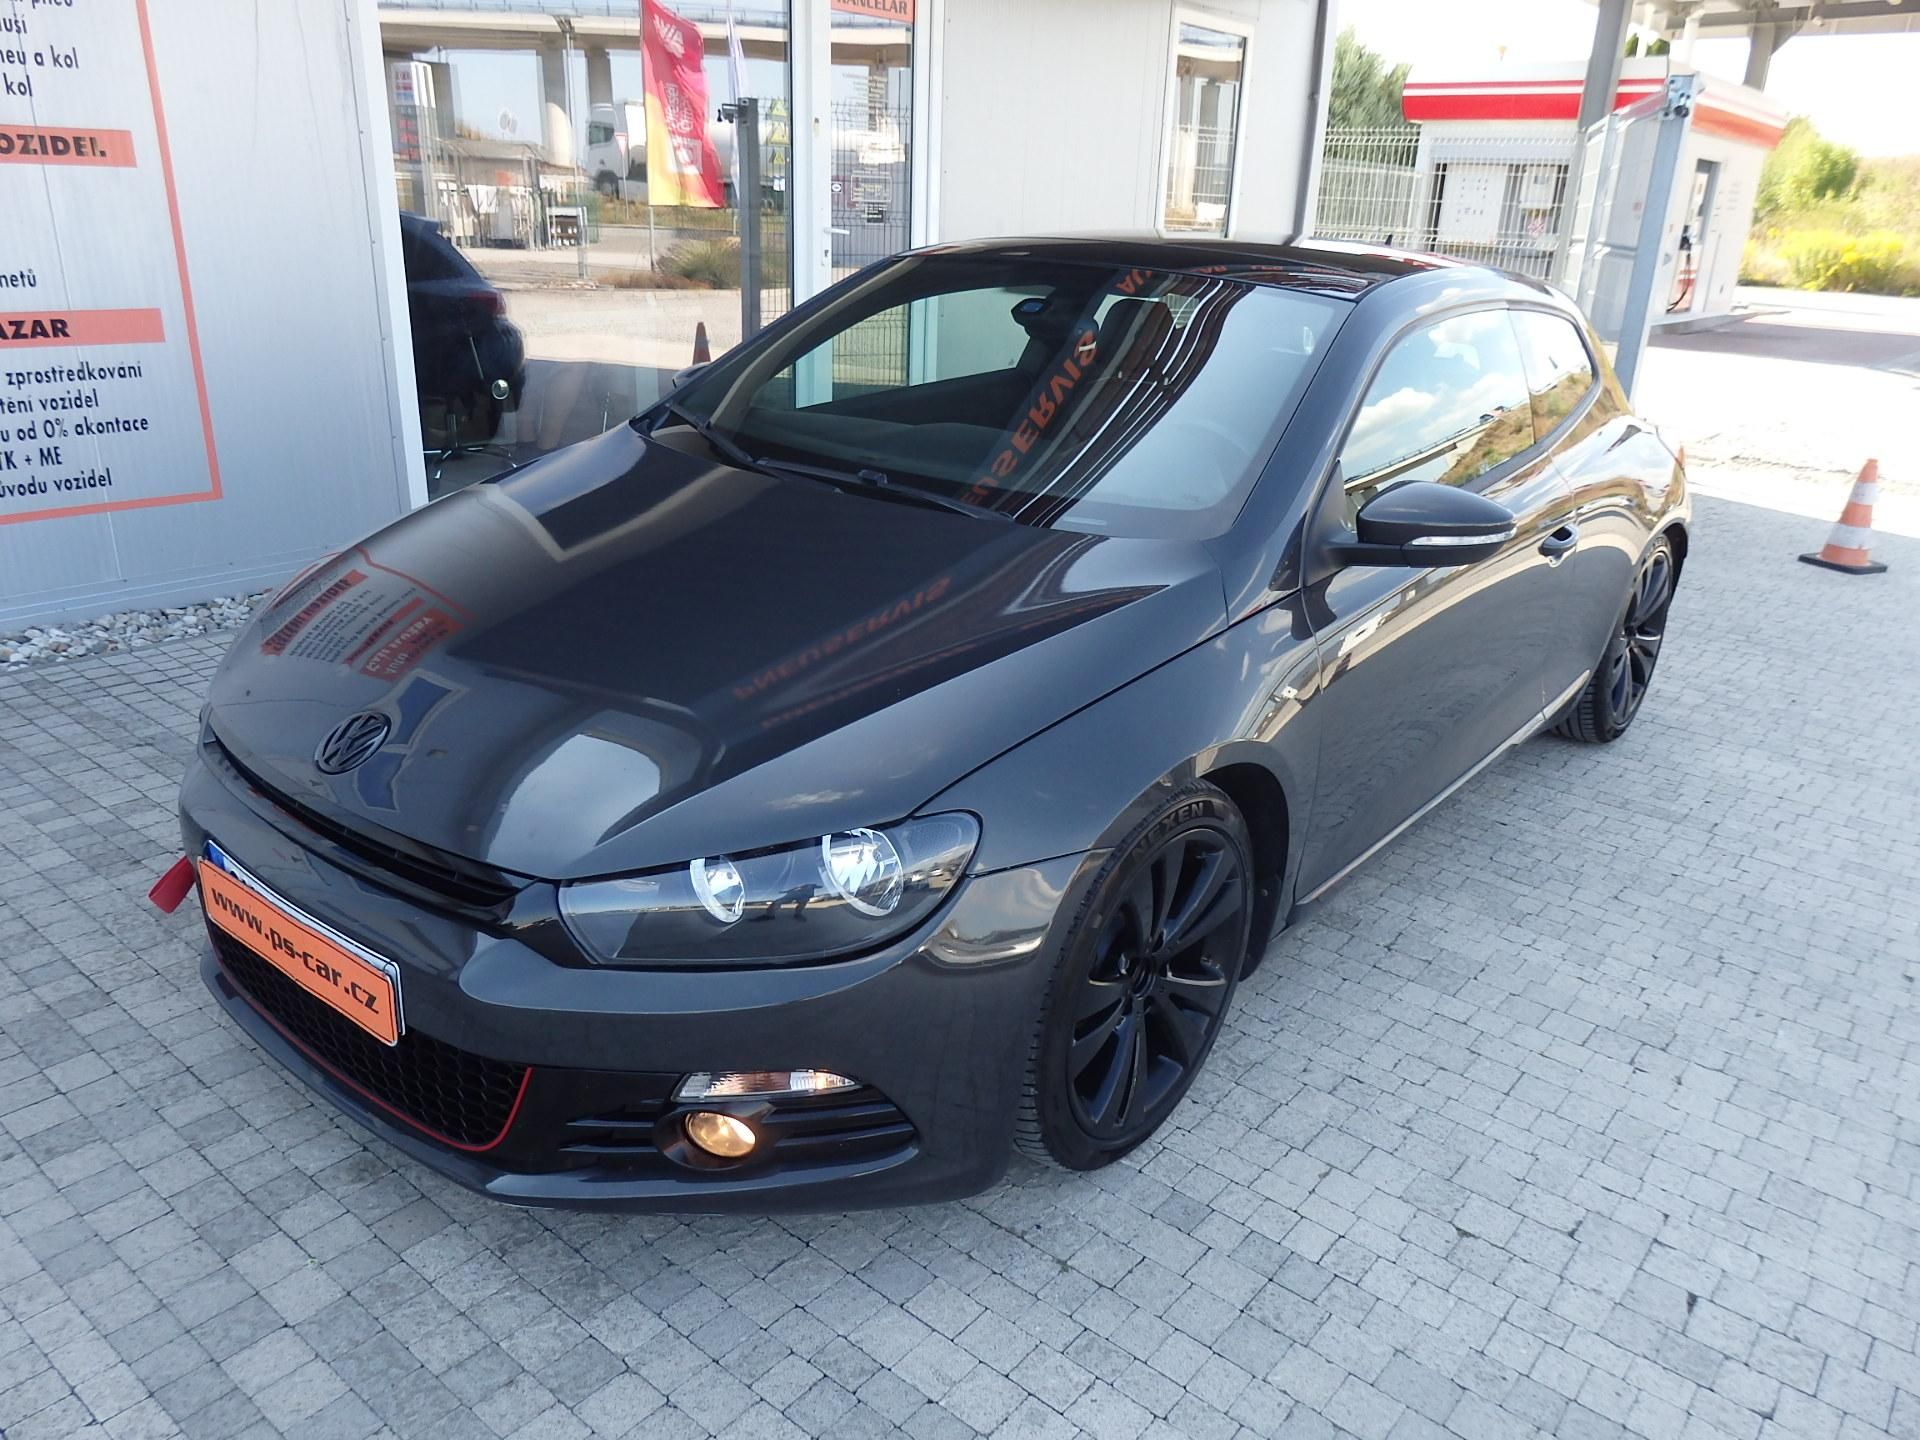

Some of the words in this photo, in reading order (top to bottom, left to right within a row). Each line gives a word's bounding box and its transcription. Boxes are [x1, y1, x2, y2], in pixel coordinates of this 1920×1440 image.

[34, 51, 44, 67] a
[50, 44, 79, 69] kol
[3, 72, 33, 97] kol
[39, 388, 99, 411] vozidel
[17, 421, 37, 441] od
[43, 417, 69, 439] 0%
[74, 416, 150, 436] akontace
[39, 446, 63, 466] ME
[53, 467, 113, 491] vozidel
[210, 887, 381, 1015] www.ps-car.cz
